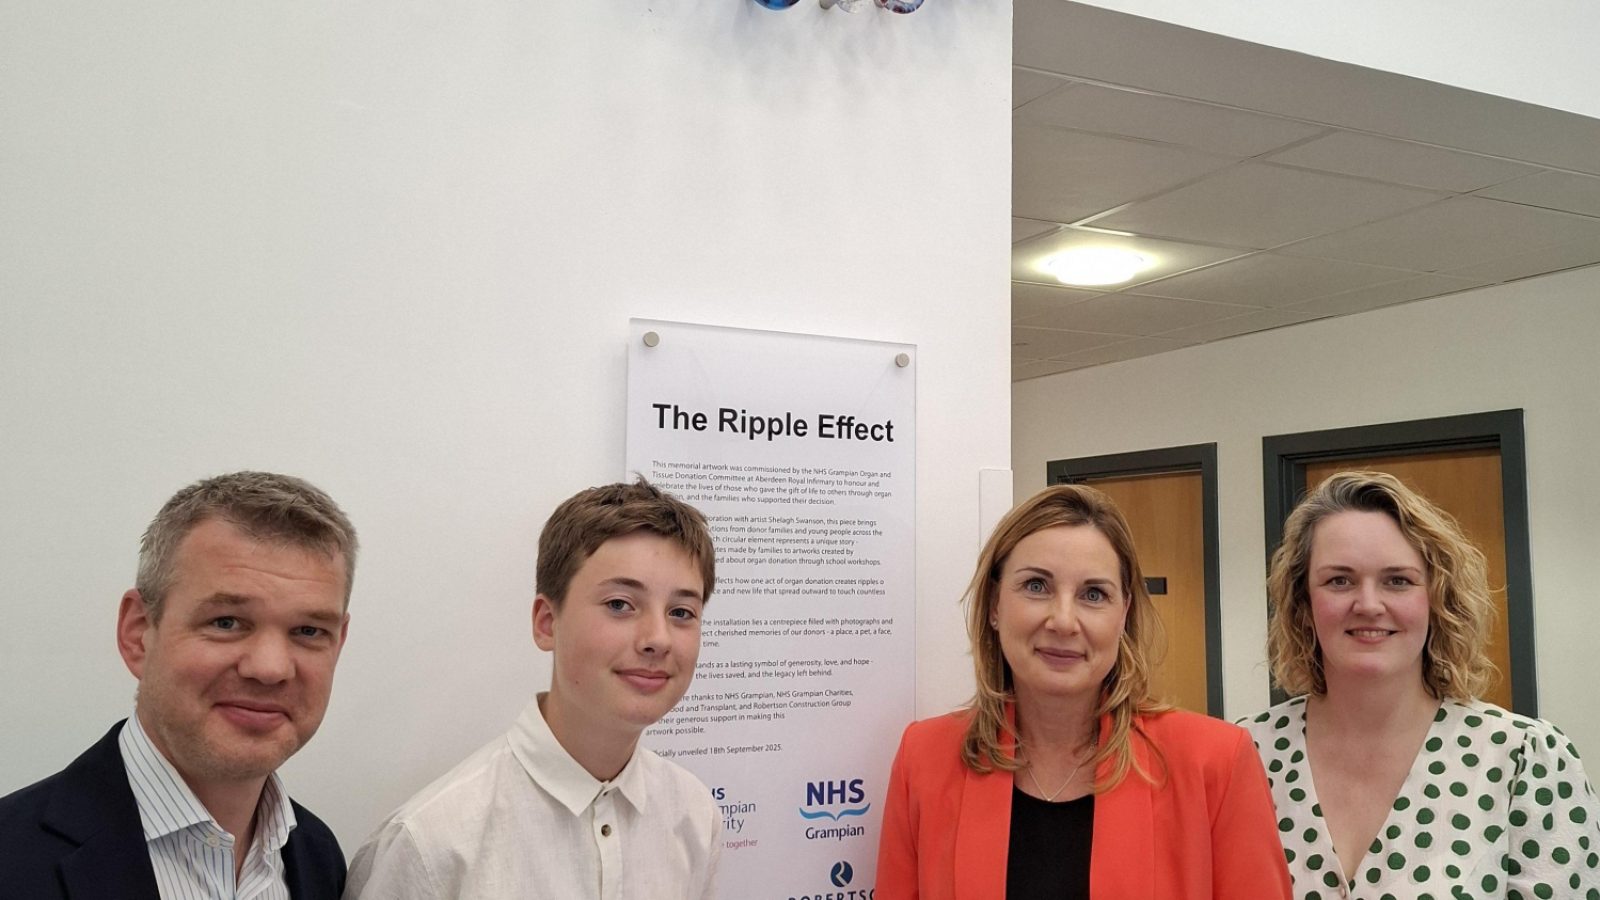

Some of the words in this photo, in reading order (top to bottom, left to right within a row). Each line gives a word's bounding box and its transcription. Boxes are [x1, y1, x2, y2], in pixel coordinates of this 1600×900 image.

[652, 403, 708, 431] The
[718, 408, 808, 441] Ripple
[818, 414, 894, 442] Effect
[828, 469, 858, 477] Grampian
[675, 472, 707, 480] Donation
[709, 473, 745, 481] Committee
[756, 475, 787, 483] Aberdeen
[788, 477, 805, 485] Royal
[807, 477, 835, 486] Infirmary
[844, 479, 866, 487] honour
[723, 484, 741, 492] those
[848, 490, 872, 498] through
[714, 494, 740, 502] families
[768, 516, 794, 524] Shelagh
[857, 519, 877, 527] brings
[768, 526, 793, 534] families
[799, 558, 825, 566] through
[858, 578, 879, 586] ripples
[769, 619, 807, 627] centrepiece
[840, 618, 880, 626] photographs
[730, 661, 753, 669] lasting
[754, 660, 778, 668] symbol
[854, 658, 869, 666] hope
[774, 670, 795, 679] legacy
[792, 690, 823, 698] Grampian
[753, 702, 787, 710] Robertson
[831, 699, 851, 707] Group
[676, 717, 709, 725] generous
[710, 715, 737, 723] support
[747, 713, 771, 721] making
[645, 728, 673, 736] artwork
[678, 748, 708, 756] unveiled
[726, 745, 763, 755] September
[806, 779, 865, 806] NHS
[805, 824, 865, 841] Grampian
